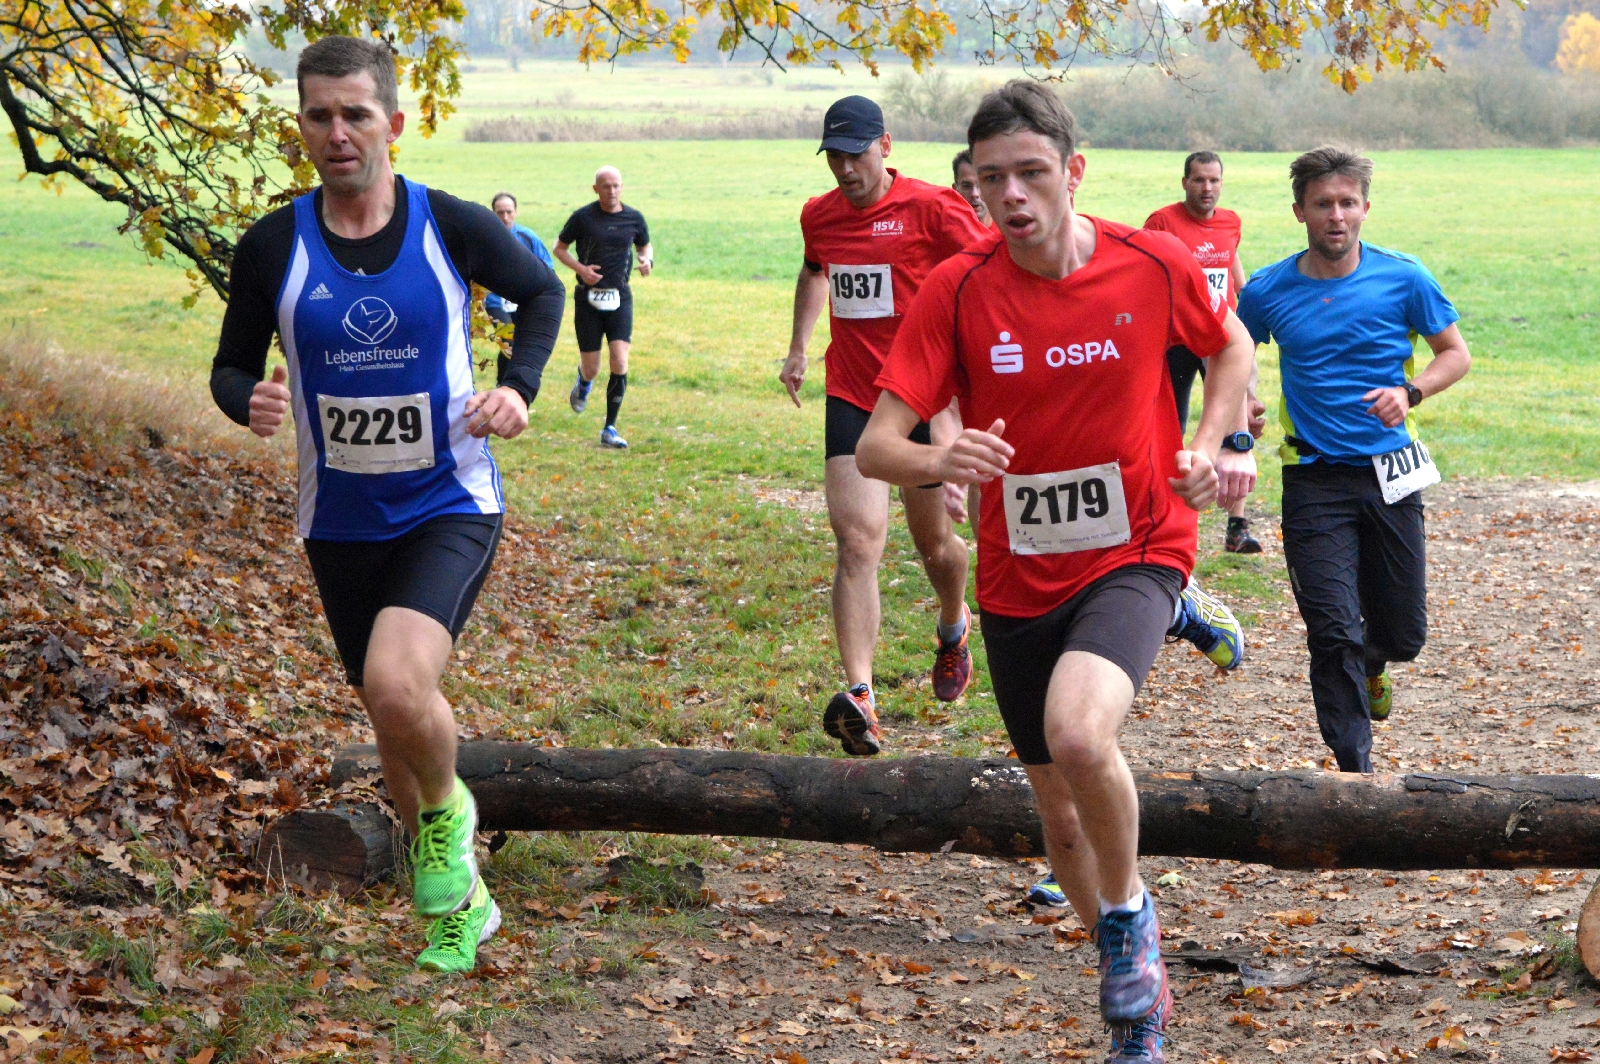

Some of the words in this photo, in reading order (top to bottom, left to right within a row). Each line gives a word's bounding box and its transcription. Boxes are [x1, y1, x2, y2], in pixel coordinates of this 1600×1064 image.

[873, 220, 896, 232] HSV
[308, 292, 334, 300] adidas
[593, 290, 616, 301] 2271
[832, 272, 883, 299] 1937
[325, 344, 420, 365] Lebensfreude
[1046, 339, 1121, 368] OSPA
[327, 405, 423, 446] 2229
[1016, 477, 1110, 525] 2179
